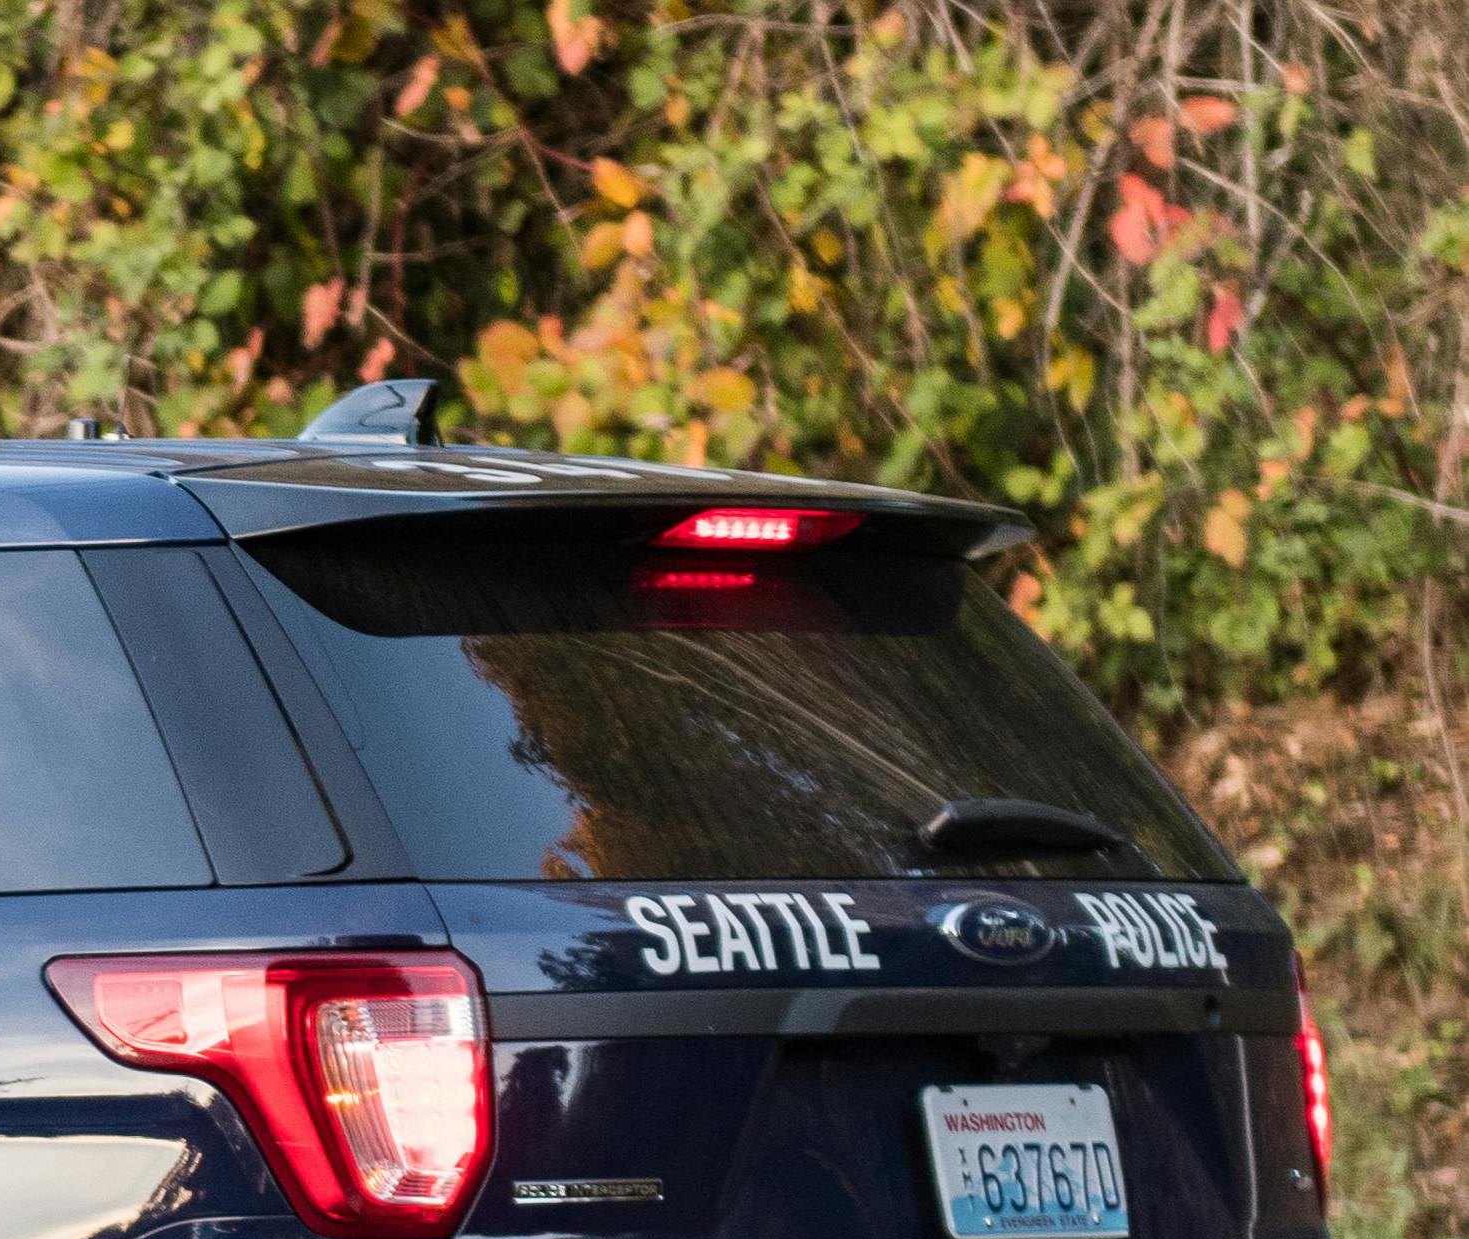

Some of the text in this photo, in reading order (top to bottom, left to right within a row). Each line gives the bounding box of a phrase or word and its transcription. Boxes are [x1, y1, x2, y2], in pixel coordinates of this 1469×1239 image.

[625, 890, 881, 976] SEATTLE
[1075, 892, 1230, 970] POLICE
[943, 1111, 1047, 1134] WASHINGTON
